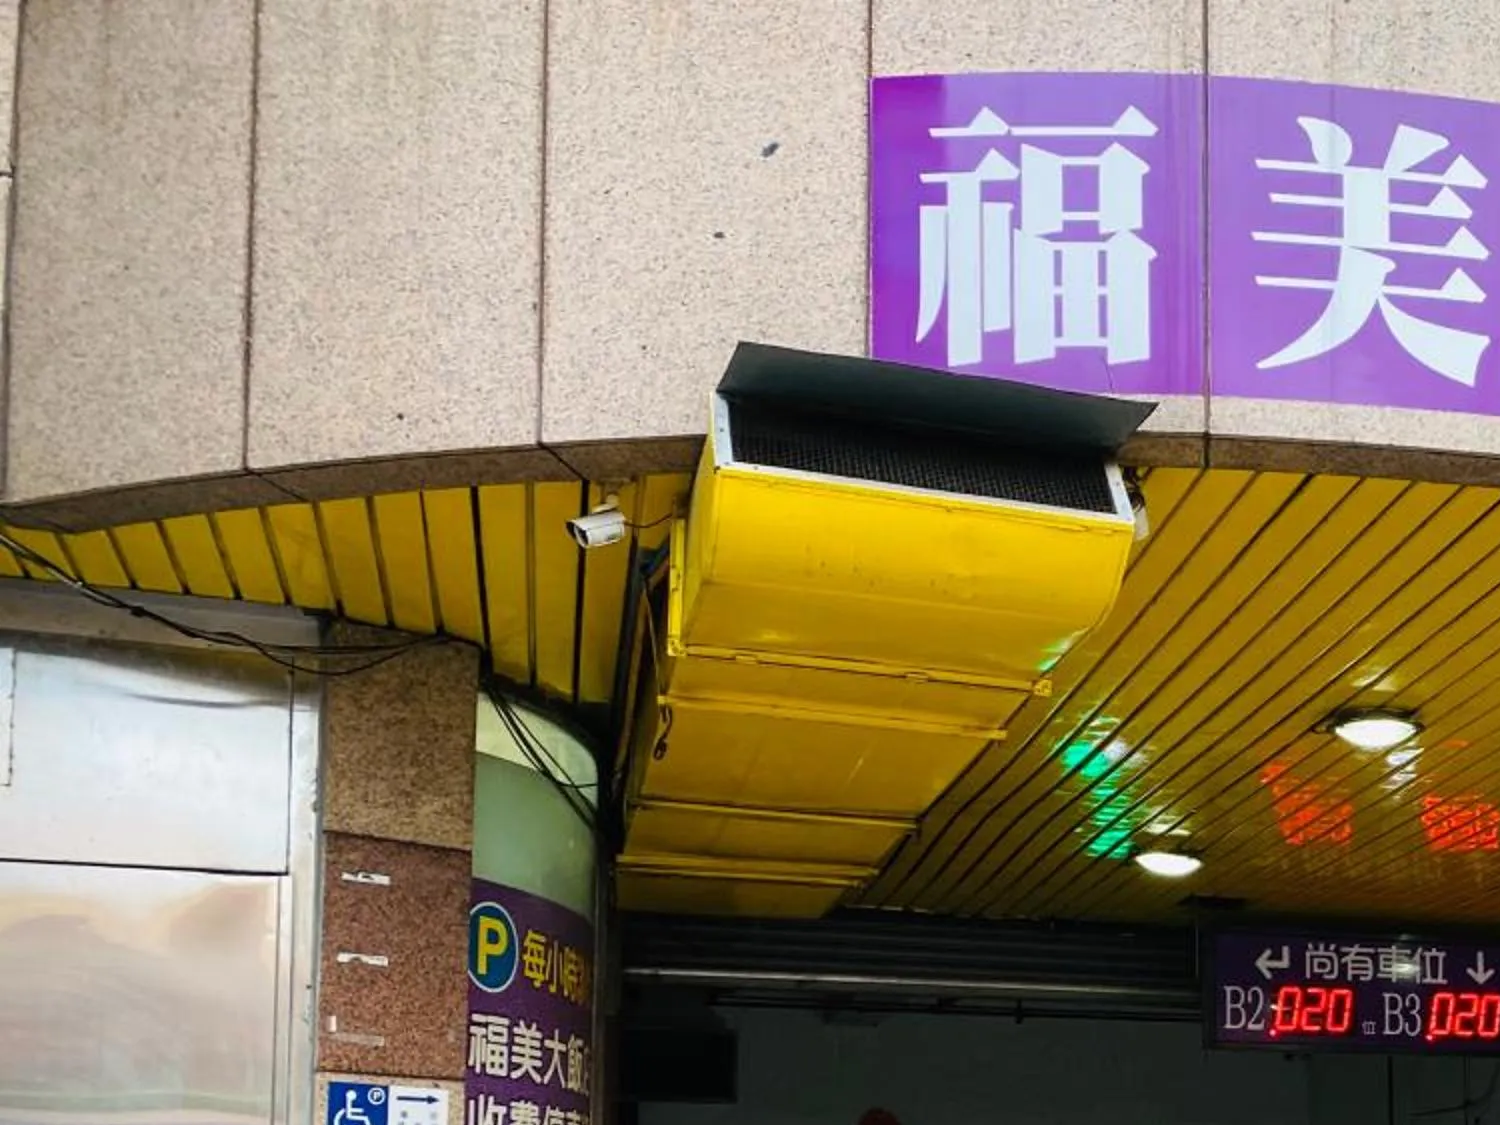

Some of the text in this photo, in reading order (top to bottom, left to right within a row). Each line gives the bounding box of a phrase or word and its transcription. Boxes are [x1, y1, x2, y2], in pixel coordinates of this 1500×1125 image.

[477, 915, 509, 975] P
[1304, 942, 1448, 985] 尚有車位
[1223, 985, 1265, 1030] B2
[1271, 986, 1353, 1034] 020
[1382, 992, 1422, 1036] B3
